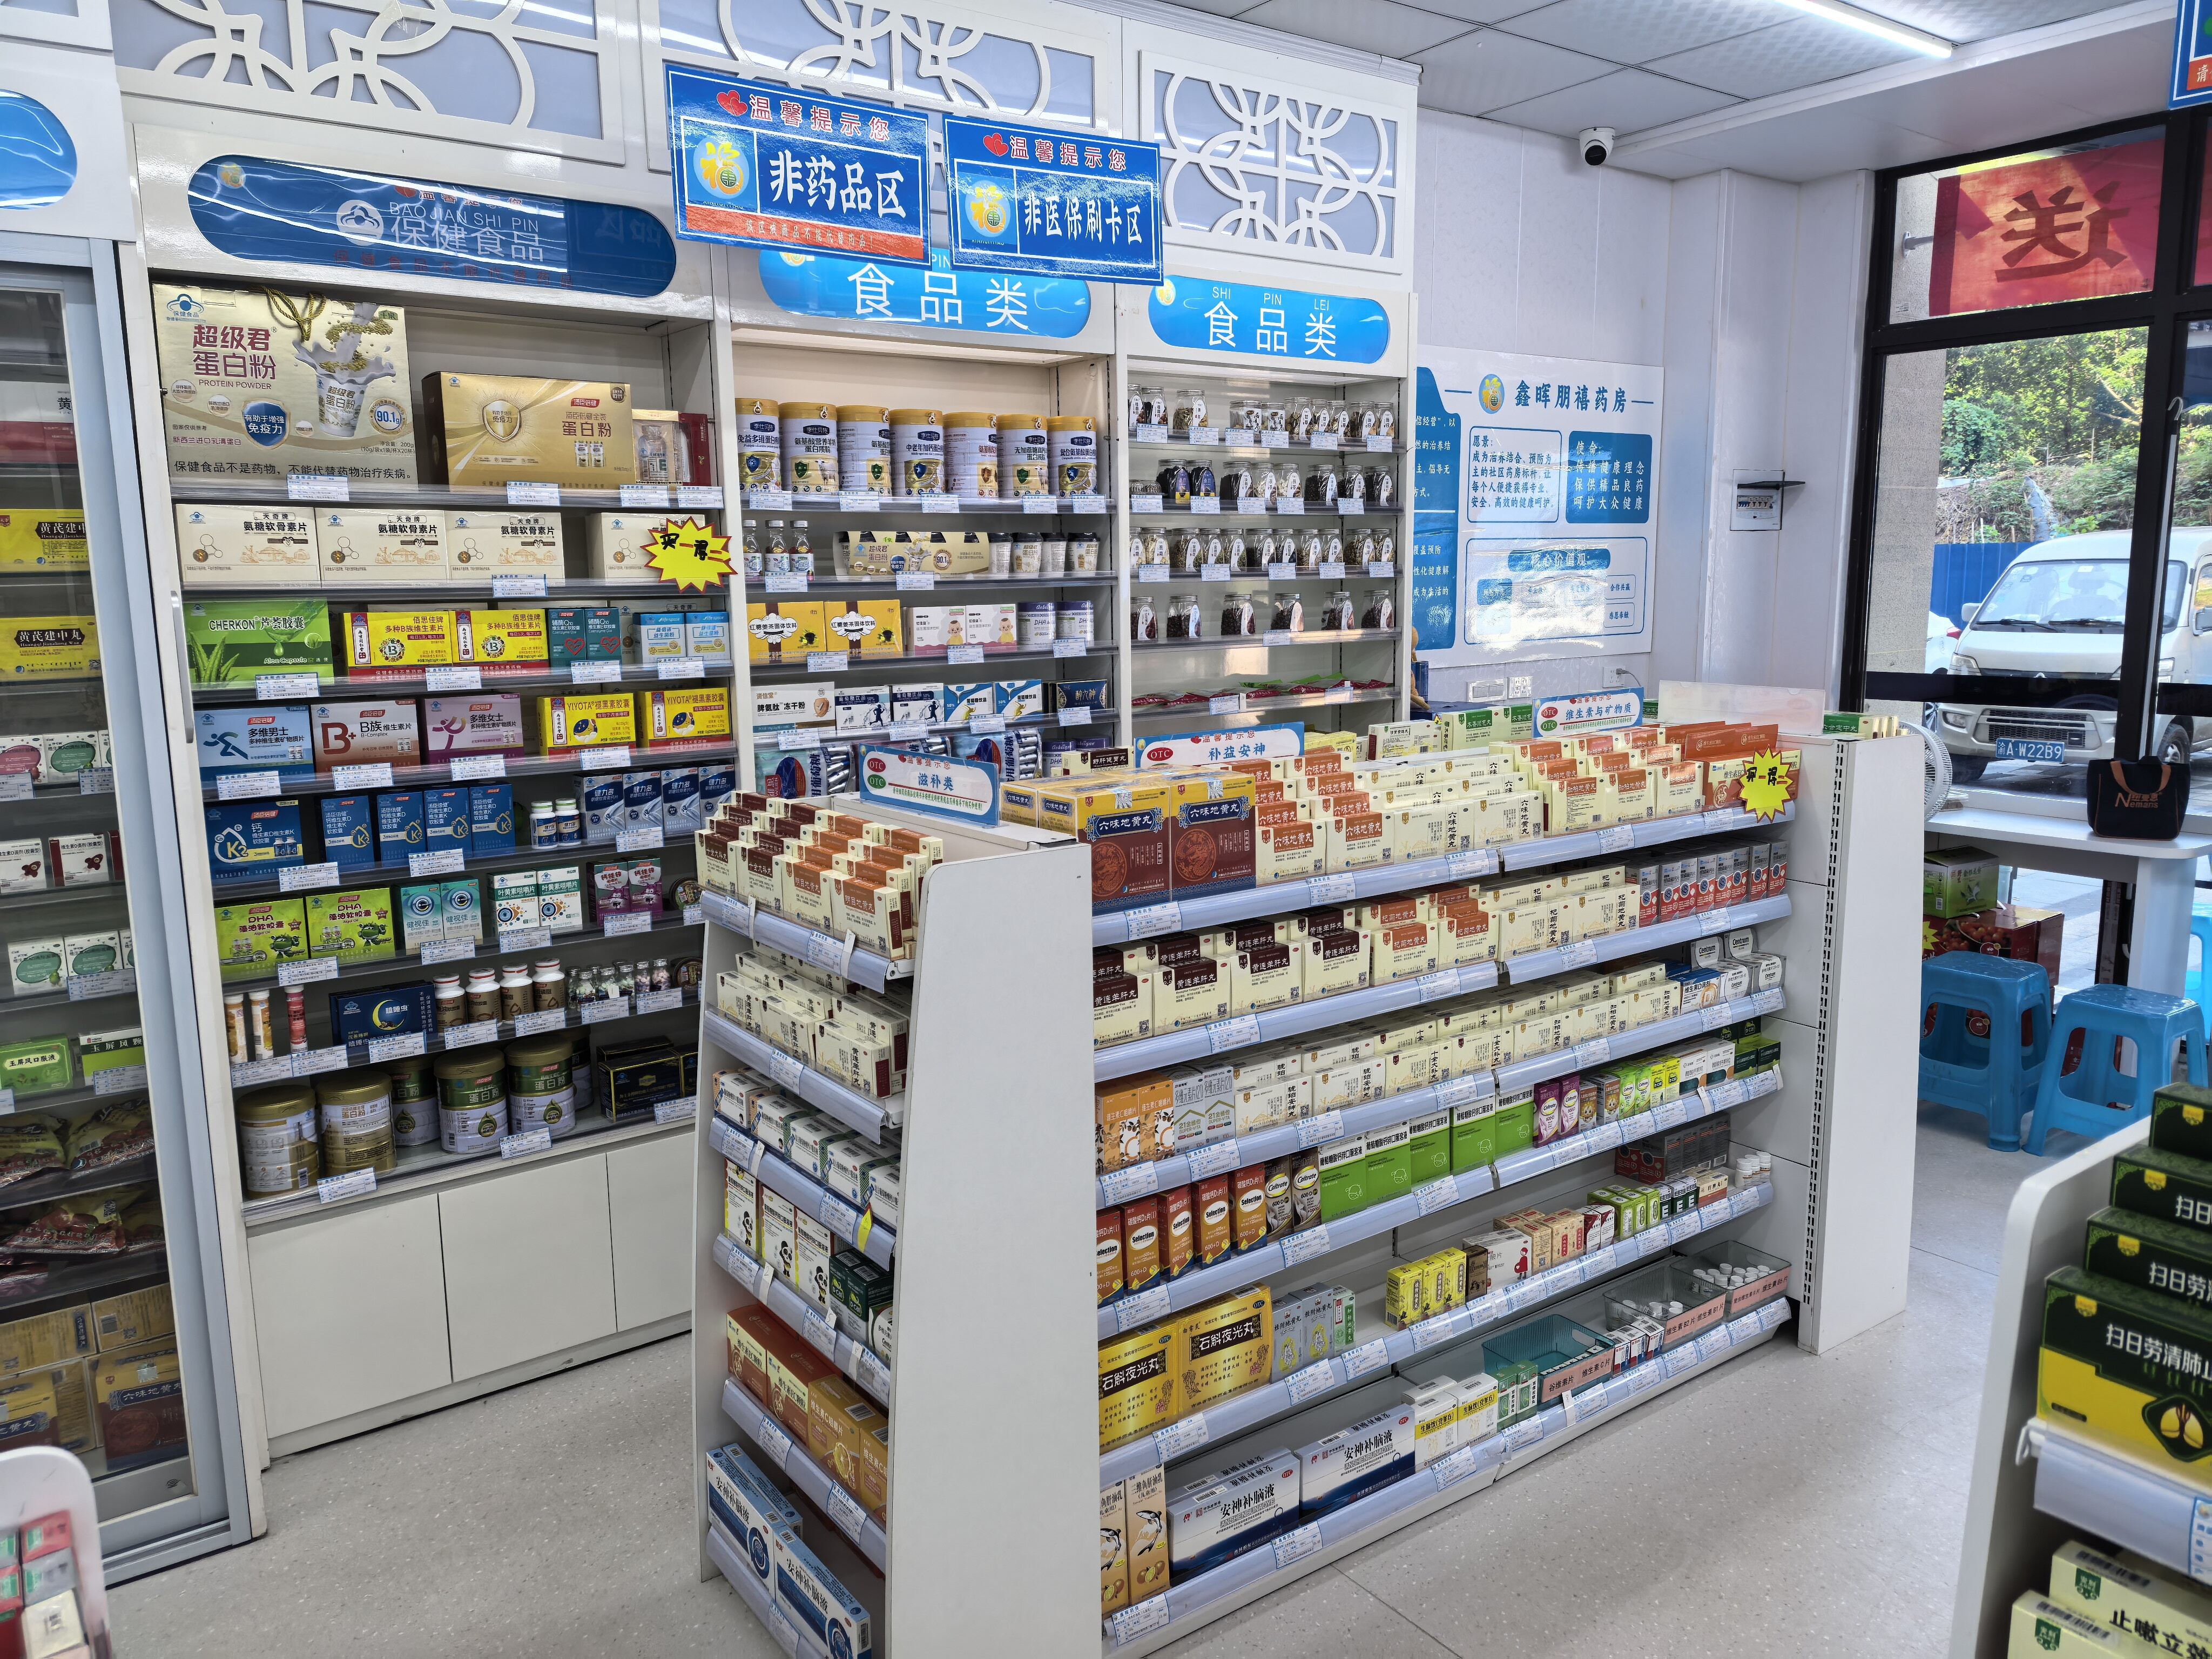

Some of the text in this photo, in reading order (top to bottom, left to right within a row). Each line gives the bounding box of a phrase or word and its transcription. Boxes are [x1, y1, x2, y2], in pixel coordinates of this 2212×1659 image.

[750, 94, 889, 141] 温馨提示您
[1011, 137, 1127, 171] 温馨提示您
[769, 150, 906, 219] 非药品区
[389, 202, 538, 232] BAO JIAN SHI PIN
[1023, 193, 1142, 246] 非医保刷卡区
[391, 216, 543, 262] 保健食品
[847, 264, 1030, 331] 食品类
[1212, 286, 1330, 311] SHI PIN LEI
[1203, 301, 1338, 358] 食品类
[193, 325, 271, 352] 超级君
[193, 351, 276, 380] 蛋白粉
[199, 380, 272, 389] PROTEIN POWDER
[1515, 380, 1627, 413] 鑫晖朋禧药房
[245, 415, 285, 423] 有助于增强
[247, 424, 282, 434] 免疫力
[562, 421, 611, 437] 蛋白粉
[1574, 478, 1643, 493] 保供精品良药
[1574, 496, 1643, 510] 呵护大众健康
[244, 521, 307, 532] 氨糖软骨素片
[379, 524, 437, 535] 氨糖软骨素片
[501, 525, 555, 536] 氨糖软骨素片
[1610, 582, 1630, 591] 合作共赢
[209, 617, 305, 631] CHERKON 芦荟胶囊
[413, 616, 444, 625] 佰思佳牌
[487, 622, 541, 630] 多种B族维生素片
[385, 624, 444, 633] 多种B族维生素片
[19, 630, 82, 642] 黄芪建中丸
[567, 699, 630, 711] YIYOTA 褪黑素胶囊
[666, 693, 725, 704] YIYOTA 褪黑素胶囊
[784, 702, 805, 711] 冻干粉
[1566, 703, 1632, 720] 维生素与矿物质
[470, 713, 504, 723] 多维女士
[248, 727, 289, 737] 多维男士
[1203, 730, 1256, 744] 温馨提示您
[1150, 750, 1171, 759] OTC
[1209, 743, 1266, 761] 补益安神
[869, 760, 884, 771] OTC
[869, 778, 884, 786] OTC
[918, 773, 954, 791] 滋补类
[1006, 793, 1029, 805] 六味地黄丸
[1046, 802, 1069, 813] 六味地黄丸
[251, 822, 262, 833] 钙
[1099, 814, 1152, 831] 六味地黄丸
[498, 885, 535, 895] 叶黄素咀嚼片
[542, 881, 577, 891] 叶黄素咀嚼片
[338, 903, 362, 912] DHA
[248, 915, 274, 923] DHA
[1732, 936, 1749, 946] Centrum
[1699, 945, 1716, 954] Centrum
[1252, 957, 1289, 972] 黄连羊肝丸
[1176, 973, 1216, 989] 黄连羊肝丸
[1095, 989, 1137, 1004] 黄连羊肝丸
[1493, 1034, 1501, 1064] 十全大补丸
[9, 1053, 56, 1067] 玉屏风口服液
[1431, 1050, 1439, 1081] 十全大补丸
[1363, 1066, 1372, 1099] 琥珀安神丸
[1363, 1068, 1371, 1098] 琥珀安神丸
[1287, 1085, 1297, 1118] 琥珀安神丸
[1297, 1172, 1317, 1183] Caltrate
[1268, 1180, 1289, 1192] Caltrate
[1205, 1206, 1225, 1218] Selection
[1173, 1215, 1190, 1229] Selection
[1132, 1230, 1155, 1242] Selection
[2149, 1262, 2212, 1303] 扫日劳
[1199, 1322, 1253, 1351] 石斛夜光丸
[1103, 1358, 1158, 1391] 石斛夜光丸
[1549, 1377, 1574, 1392] 谷维素片
[1344, 1430, 1393, 1461] 安神补脑液
[716, 1476, 750, 1526] 安神补脑液
[1220, 1483, 1274, 1519] 安神补脑液
